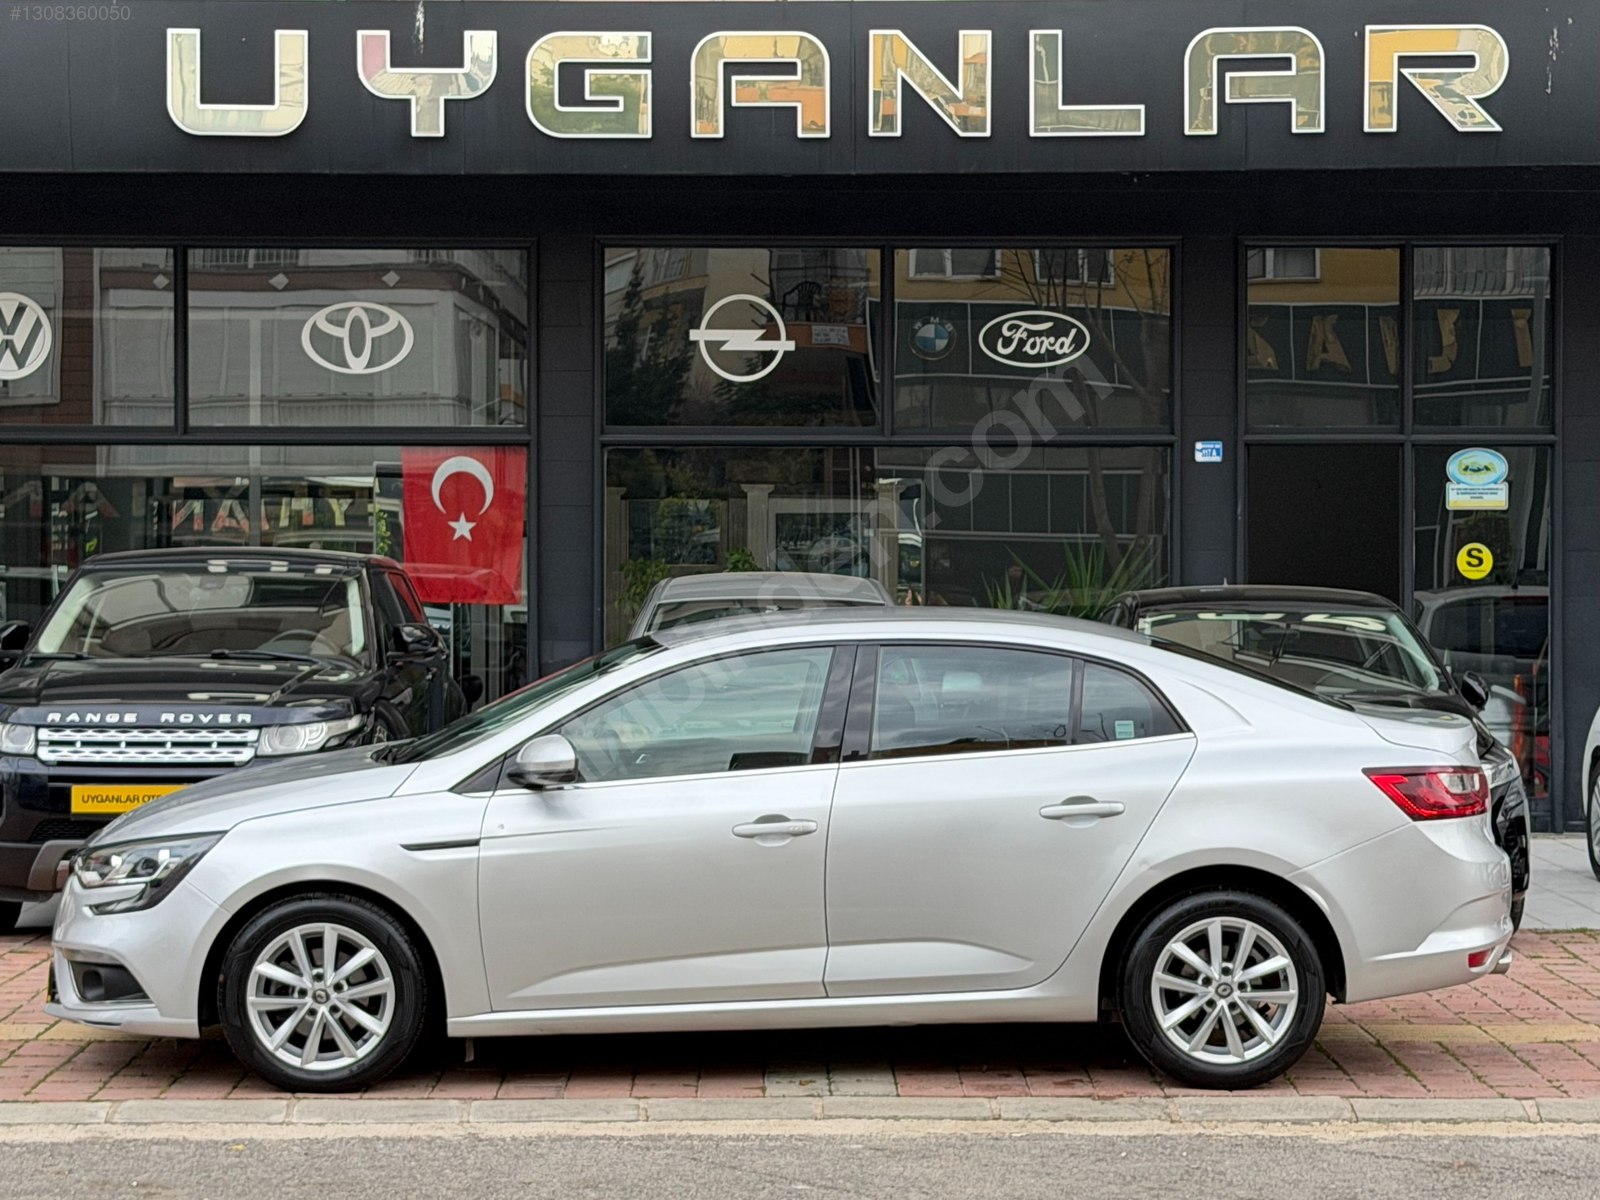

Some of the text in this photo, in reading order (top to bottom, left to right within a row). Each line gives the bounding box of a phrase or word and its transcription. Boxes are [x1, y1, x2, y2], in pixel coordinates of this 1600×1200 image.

[166, 24, 1510, 139] UYGANLAR
[996, 319, 1078, 356] Ford
[1465, 547, 1485, 568] S
[46, 712, 252, 724] RANGE ROVER
[81, 795, 140, 804] UYGANLAR
